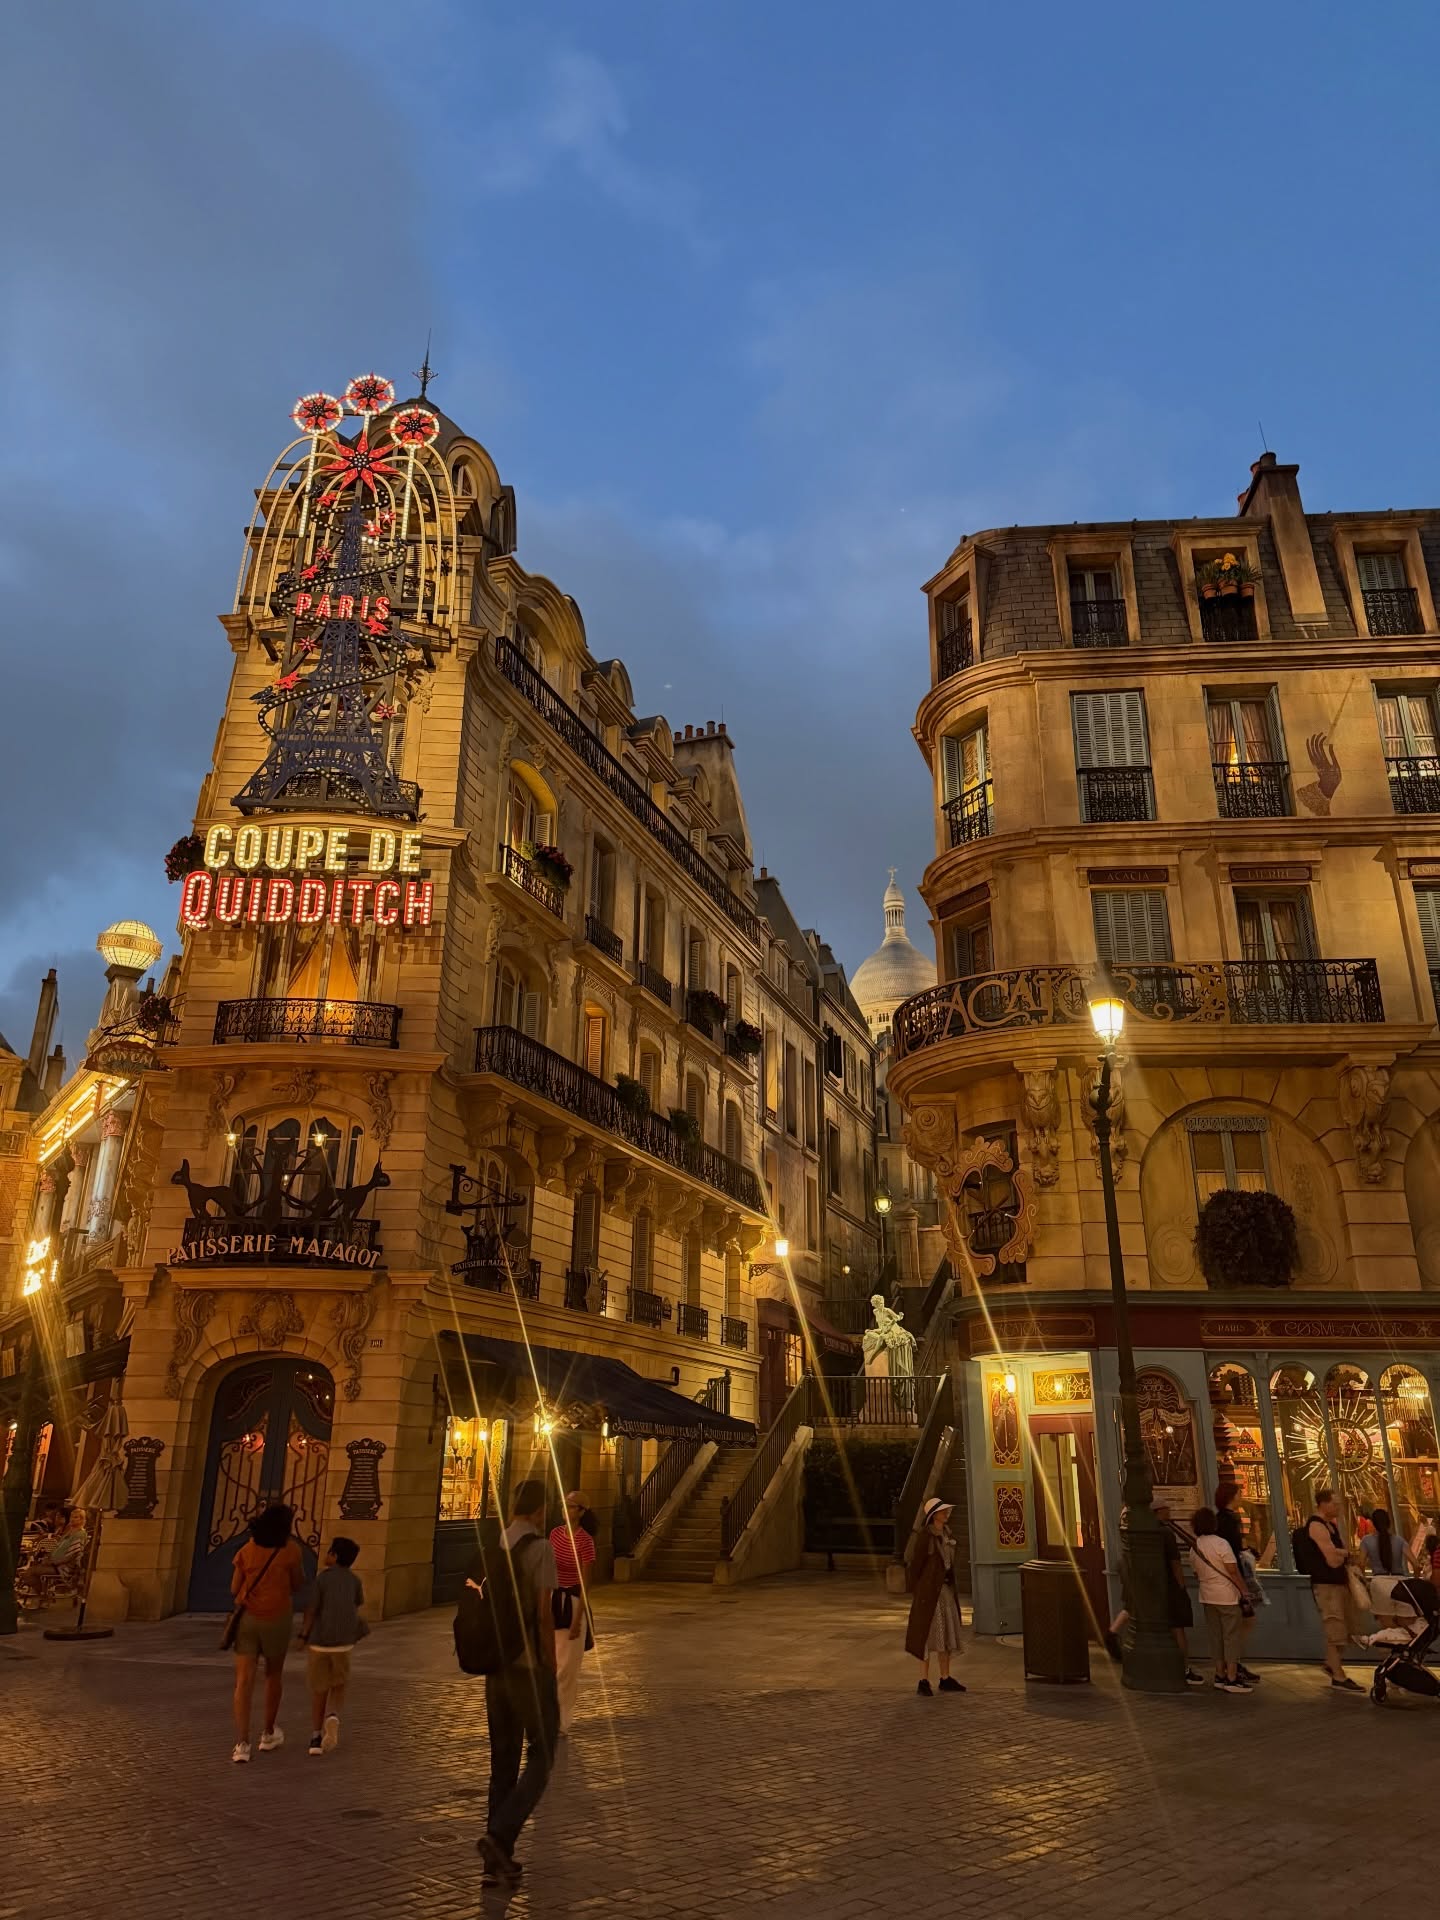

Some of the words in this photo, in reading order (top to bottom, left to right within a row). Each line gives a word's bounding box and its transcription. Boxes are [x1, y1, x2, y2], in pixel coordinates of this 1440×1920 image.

[295, 593, 391, 620] PARIS
[204, 823, 350, 870] COUPE
[368, 828, 424, 872] DE
[1106, 871, 1151, 882] ACACIA
[179, 870, 434, 929] QUIDDITCH
[166, 1233, 277, 1266] PATISSERIE
[288, 1236, 381, 1269] MATAGOT
